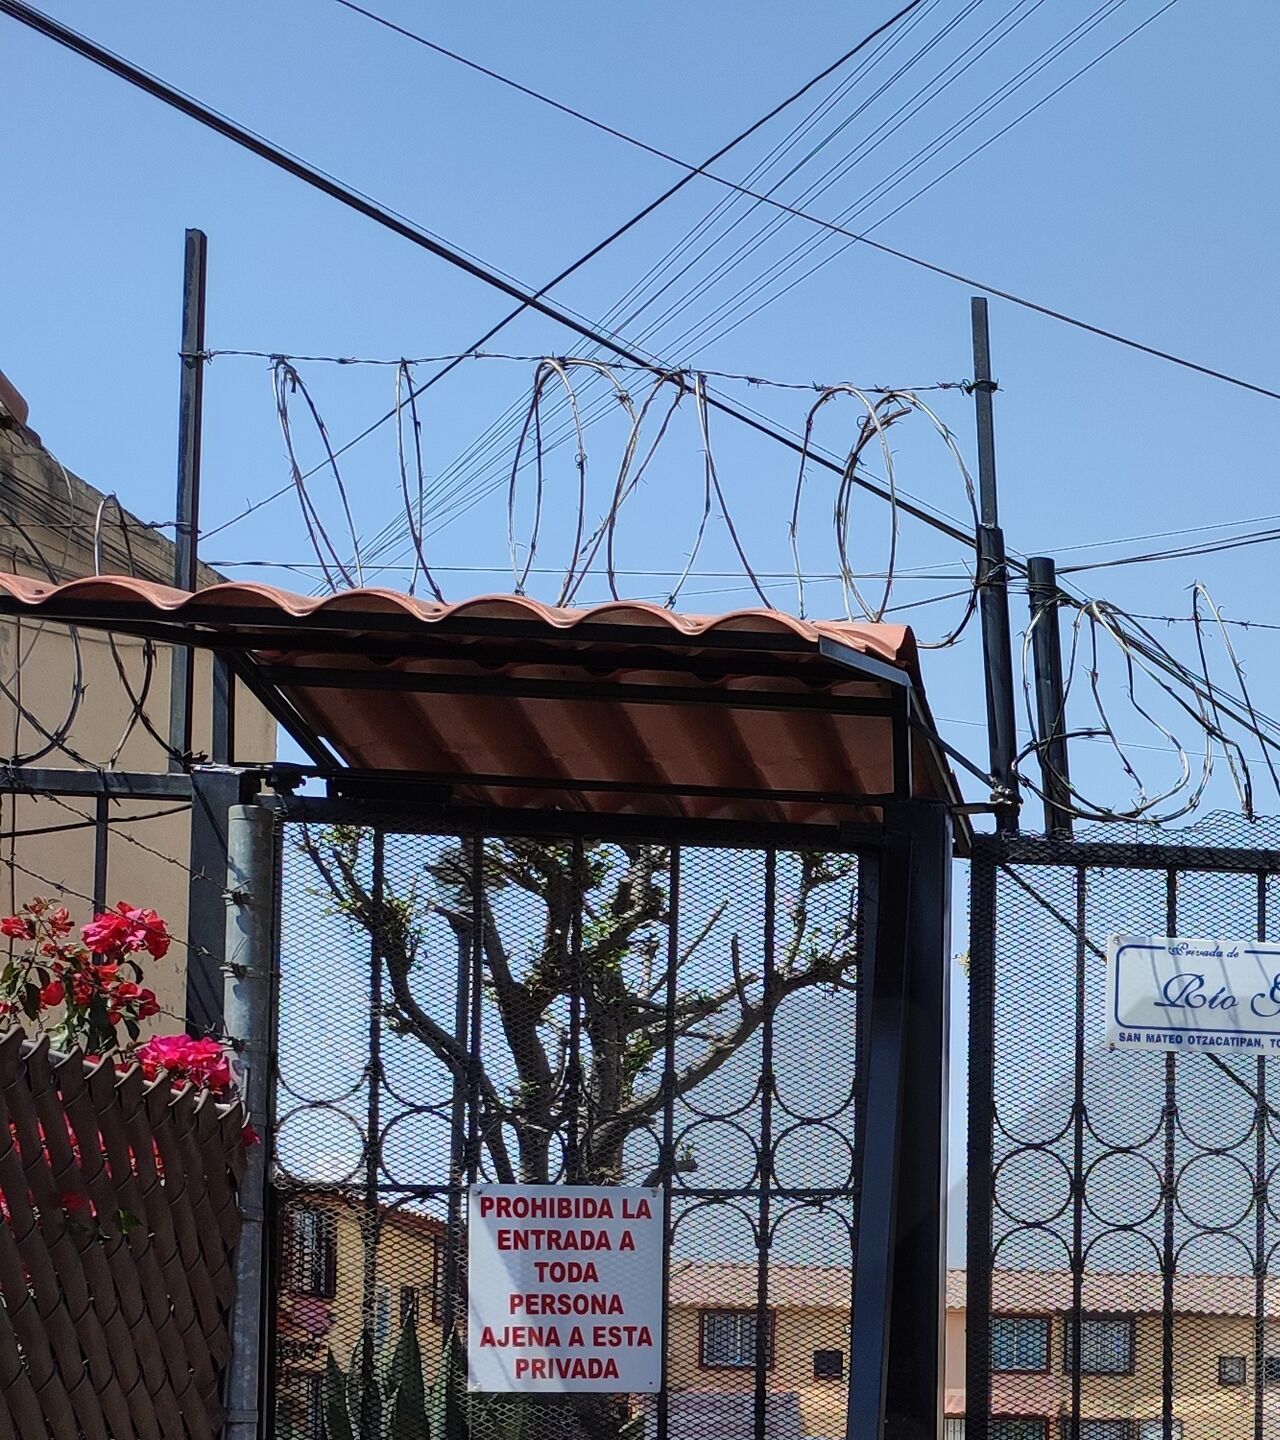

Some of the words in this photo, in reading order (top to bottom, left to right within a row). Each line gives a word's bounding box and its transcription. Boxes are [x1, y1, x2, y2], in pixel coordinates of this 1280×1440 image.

[1168, 942, 1223, 957] Privada
[1227, 946, 1239, 958] de
[1118, 1032, 1141, 1042] SAN
[1146, 1033, 1183, 1045] MATEO
[1187, 1035, 1264, 1049] OTZACATIPAN,
[480, 1196, 614, 1219] PROHIBIDA
[622, 1198, 652, 1219] LA
[497, 1229, 611, 1251] ENTRADA
[619, 1230, 636, 1251] A
[534, 1261, 599, 1283] TODA
[509, 1293, 625, 1315] PERSONA
[480, 1326, 561, 1348] AJENA
[568, 1326, 585, 1348] A
[592, 1326, 653, 1348] ESTA
[515, 1358, 620, 1380] PRIVADA
